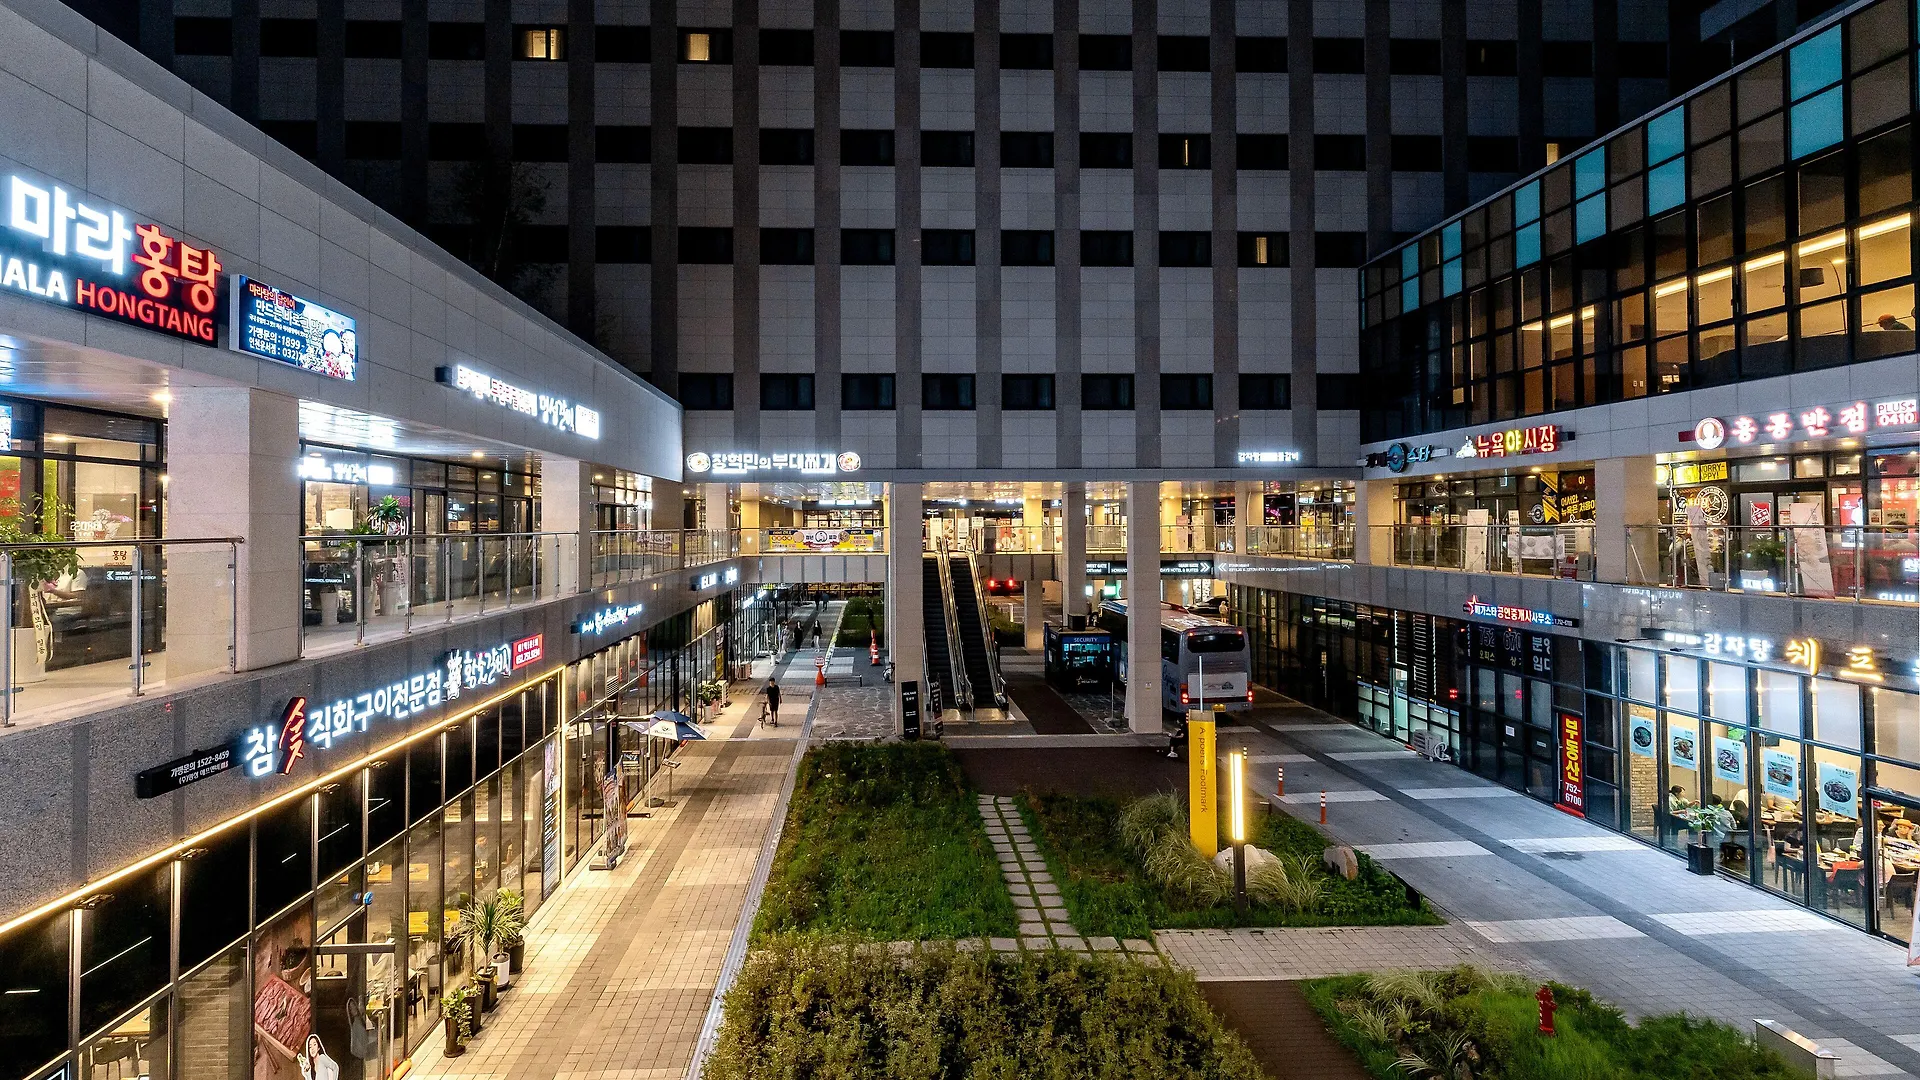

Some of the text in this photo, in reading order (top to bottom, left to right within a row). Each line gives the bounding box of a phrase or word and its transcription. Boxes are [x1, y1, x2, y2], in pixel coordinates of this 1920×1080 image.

[0, 254, 68, 301] ALA
[77, 279, 214, 341] HONGTANG
[282, 335, 300, 349] 1899
[1877, 402, 1915, 415] PLUS+
[1731, 401, 1869, 443] 홍콩반점
[1878, 413, 1916, 426] 0410
[1476, 425, 1556, 459] 뉴욕야시장
[712, 453, 837, 472] 장혁민의 부대찌개
[1703, 632, 1772, 662] 감자탕
[308, 669, 441, 750] 직화구이전문점
[197, 750, 230, 769] 1522-8459
[1565, 718, 1579, 782] 부동산
[1565, 782, 1581, 794] 752-
[1565, 793, 1582, 807] 6700
